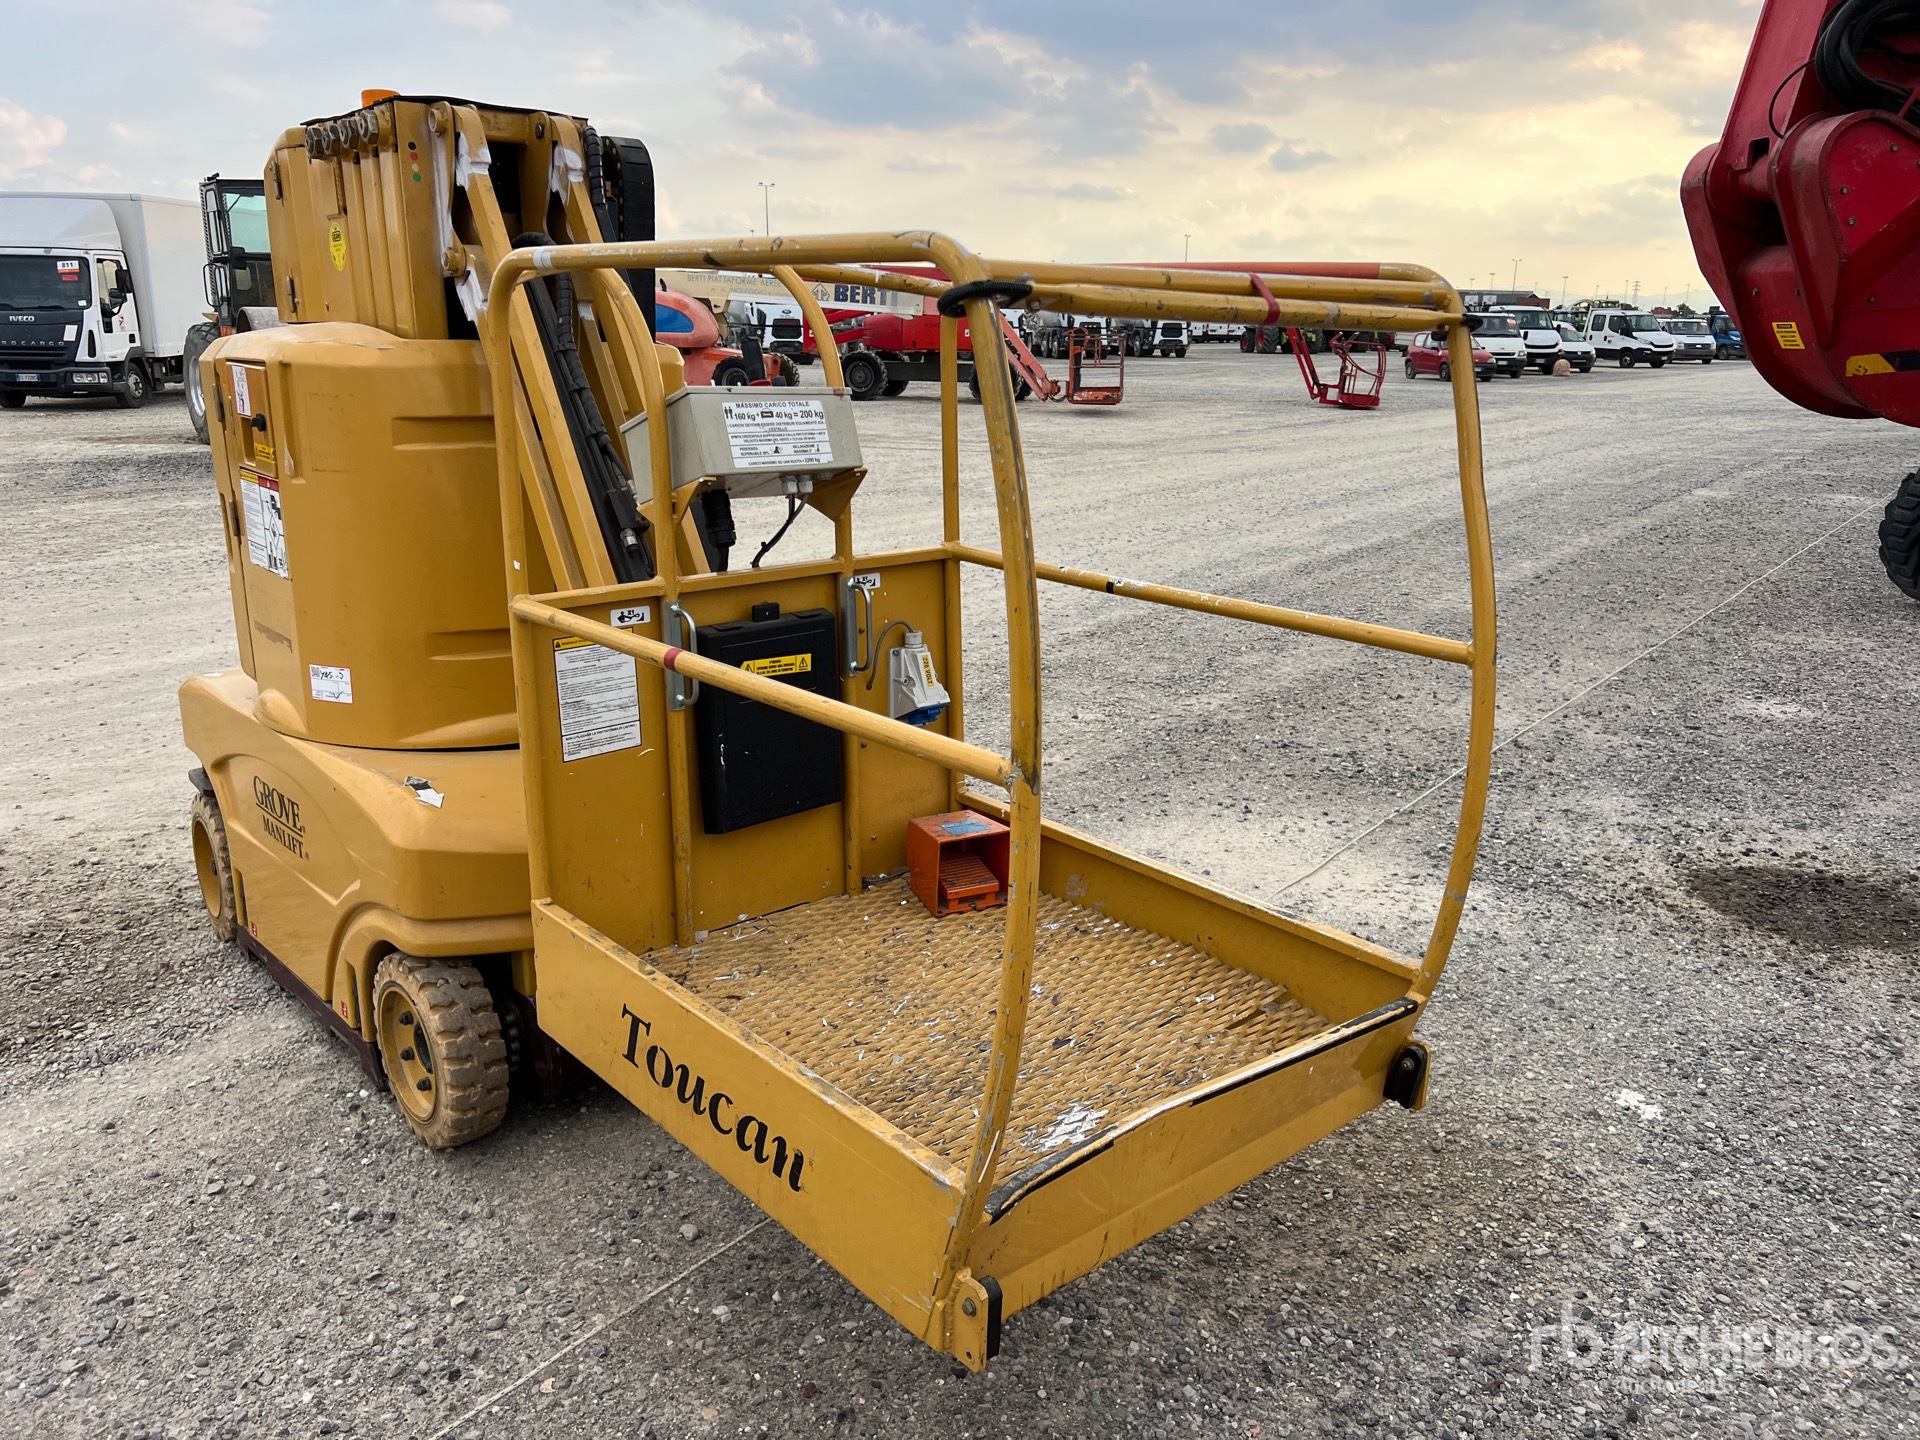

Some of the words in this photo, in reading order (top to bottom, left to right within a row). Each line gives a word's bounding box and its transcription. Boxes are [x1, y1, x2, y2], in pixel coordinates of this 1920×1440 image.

[688, 274, 706, 282] BERTI
[708, 275, 757, 286] PIATTAFORME
[761, 279, 782, 288] AEREE
[834, 284, 898, 306] BERTI
[784, 412, 792, 420] kg
[800, 410, 813, 418] 200
[814, 410, 824, 419] kg
[254, 776, 303, 832] GROVE
[262, 814, 304, 859] MANLIFT
[621, 1003, 804, 1192] Toucan
